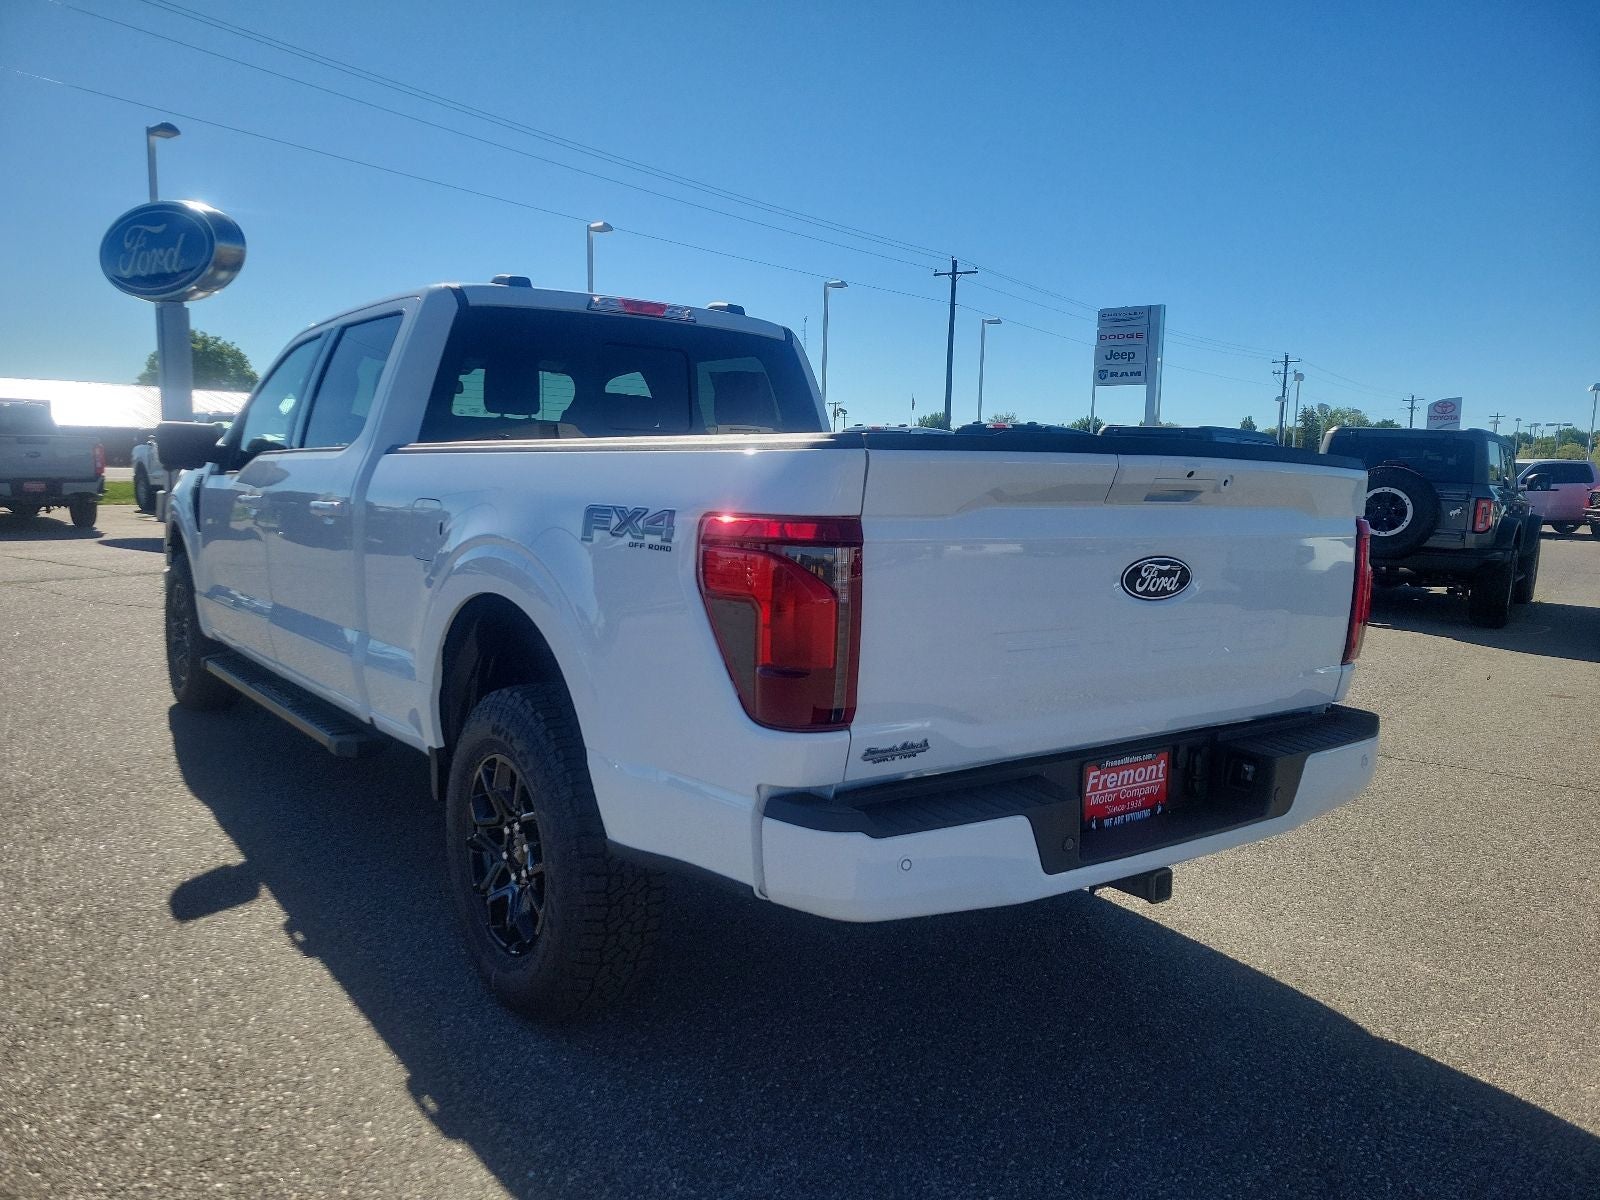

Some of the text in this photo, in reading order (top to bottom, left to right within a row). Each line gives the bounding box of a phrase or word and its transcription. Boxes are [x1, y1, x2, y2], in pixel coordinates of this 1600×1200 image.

[119, 224, 185, 278] Ford
[1099, 332, 1144, 340] DODGE
[1105, 350, 1135, 361] Jeep
[581, 504, 676, 542] FX4
[648, 544, 672, 552] ROAD
[1136, 564, 1181, 592] Ford
[1086, 760, 1165, 792] Fremont
[1090, 785, 1160, 805] Motor Company
